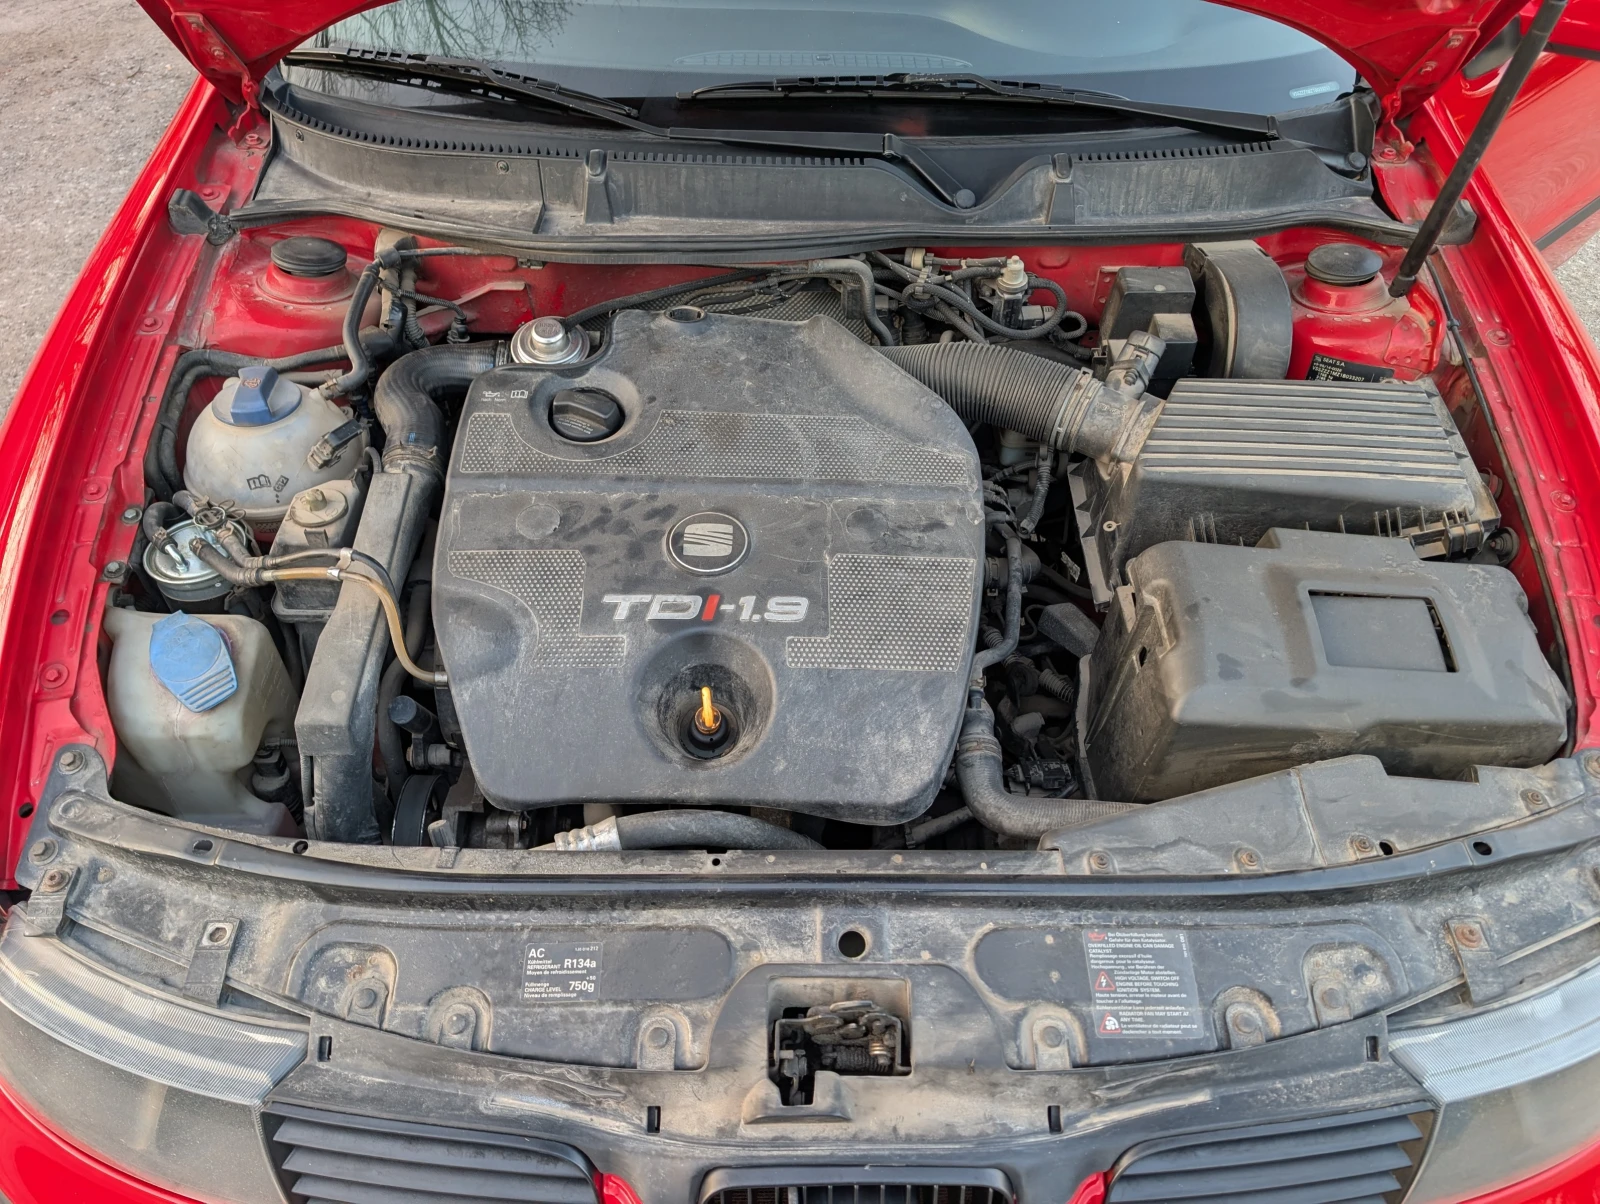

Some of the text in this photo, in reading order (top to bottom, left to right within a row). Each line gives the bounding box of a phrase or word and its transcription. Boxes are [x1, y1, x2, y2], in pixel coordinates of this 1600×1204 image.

[528, 948, 546, 958] AC
[564, 958, 596, 969] R134a
[569, 981, 595, 992] 750g
